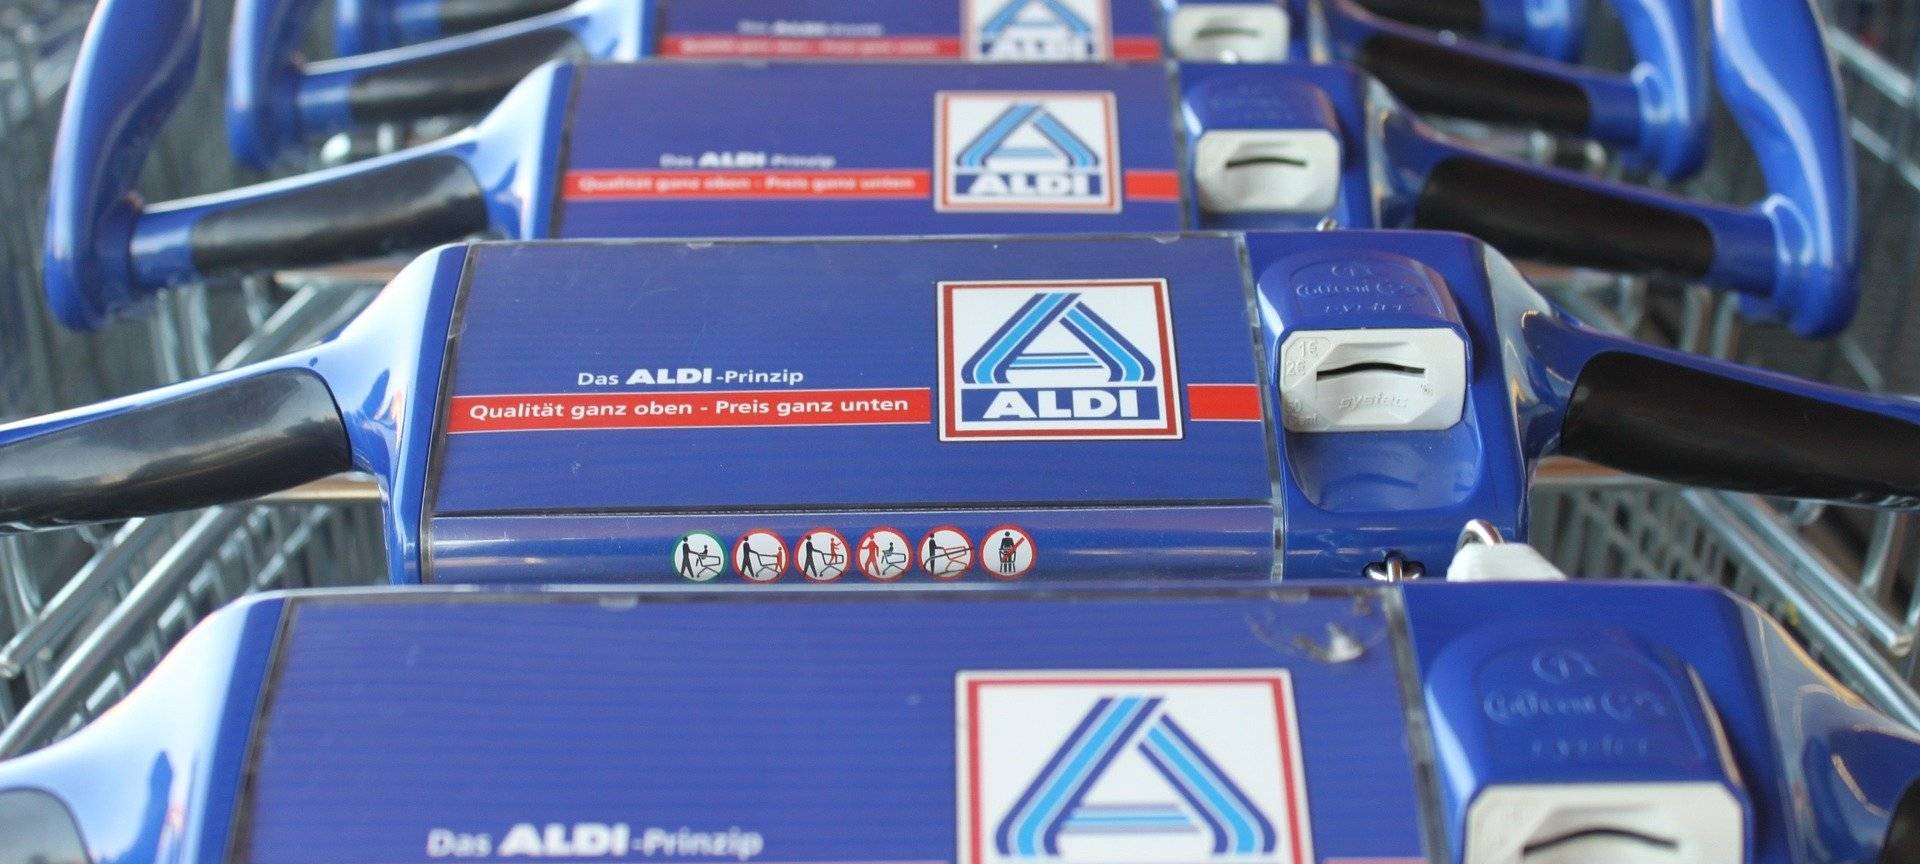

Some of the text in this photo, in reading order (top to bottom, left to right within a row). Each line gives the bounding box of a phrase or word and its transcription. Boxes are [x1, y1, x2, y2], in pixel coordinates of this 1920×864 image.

[968, 174, 1088, 195] ALDI
[577, 372, 619, 386] Das
[469, 402, 564, 421] Qualität
[570, 404, 627, 420] ganz
[634, 400, 693, 416] oben
[715, 399, 770, 415] Preis
[776, 401, 833, 417] ganz
[840, 398, 909, 412] unten
[982, 389, 1139, 419] ALDI
[427, 828, 491, 857] Das
